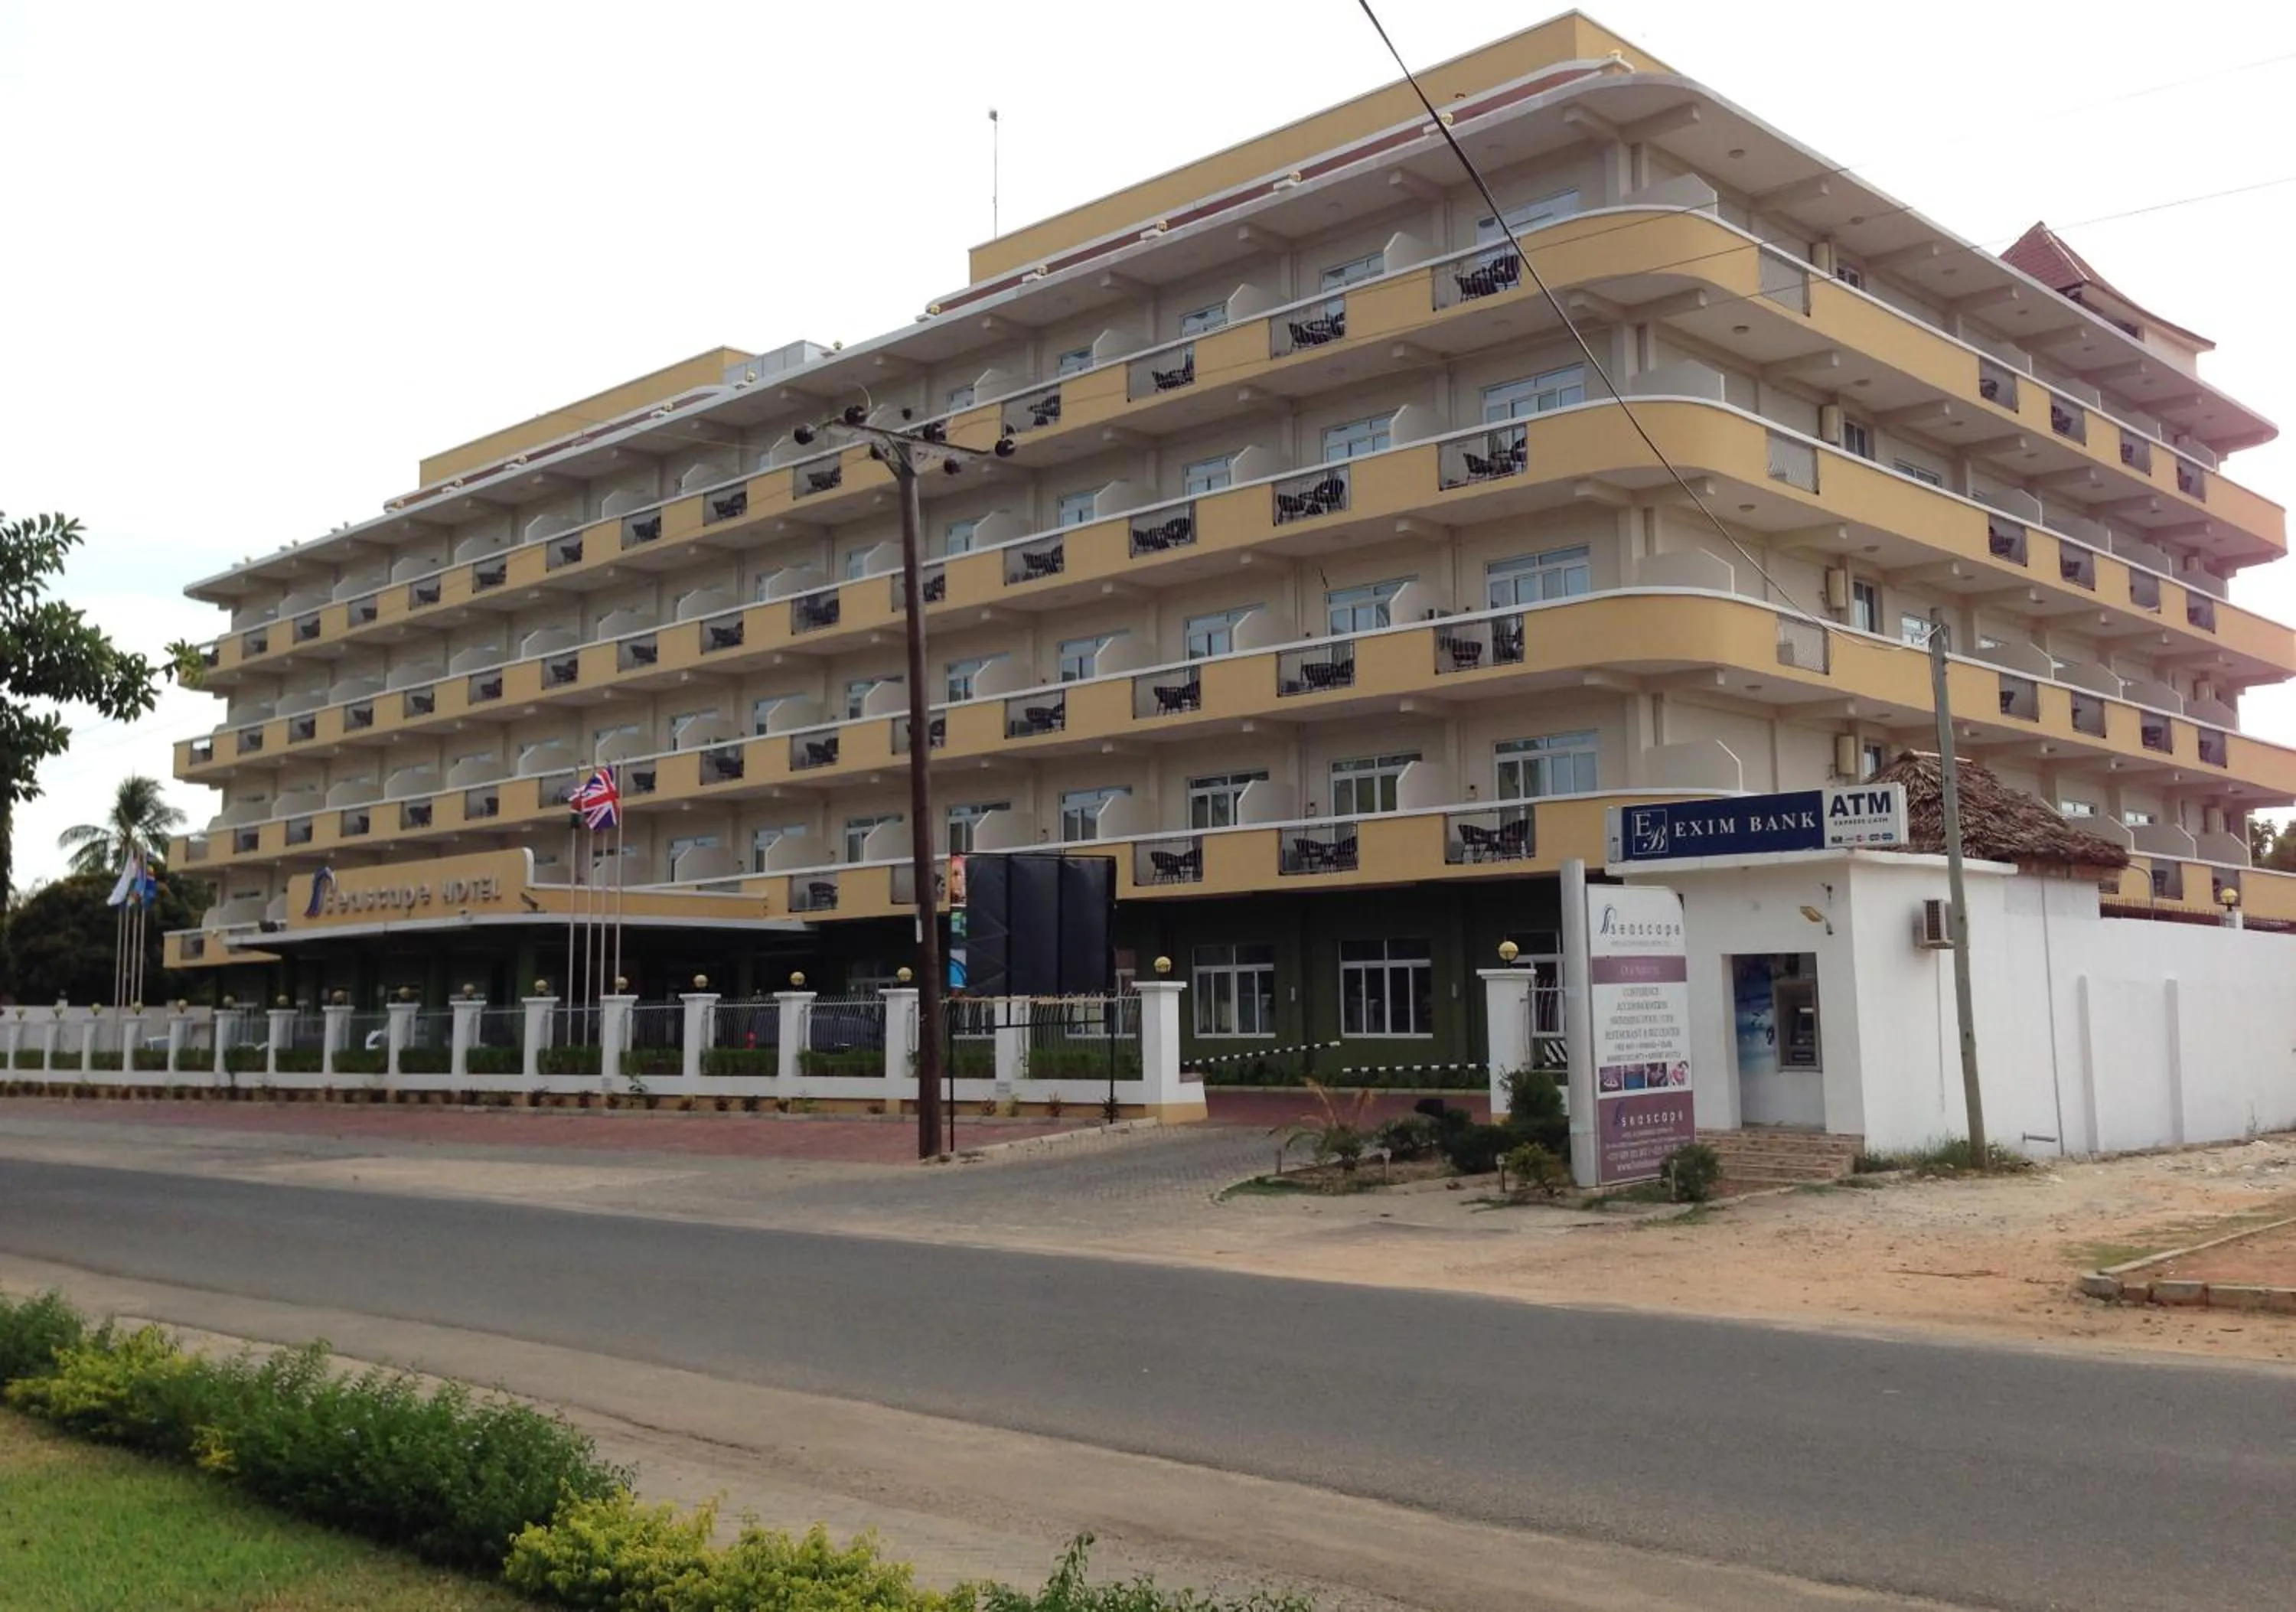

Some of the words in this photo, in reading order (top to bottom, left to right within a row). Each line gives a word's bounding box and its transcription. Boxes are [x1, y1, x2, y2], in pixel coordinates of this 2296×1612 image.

[1829, 791, 1891, 817] ATM
[1675, 817, 1736, 837] EXIM
[1750, 811, 1815, 832] BANK
[442, 876, 502, 905] HOTEL
